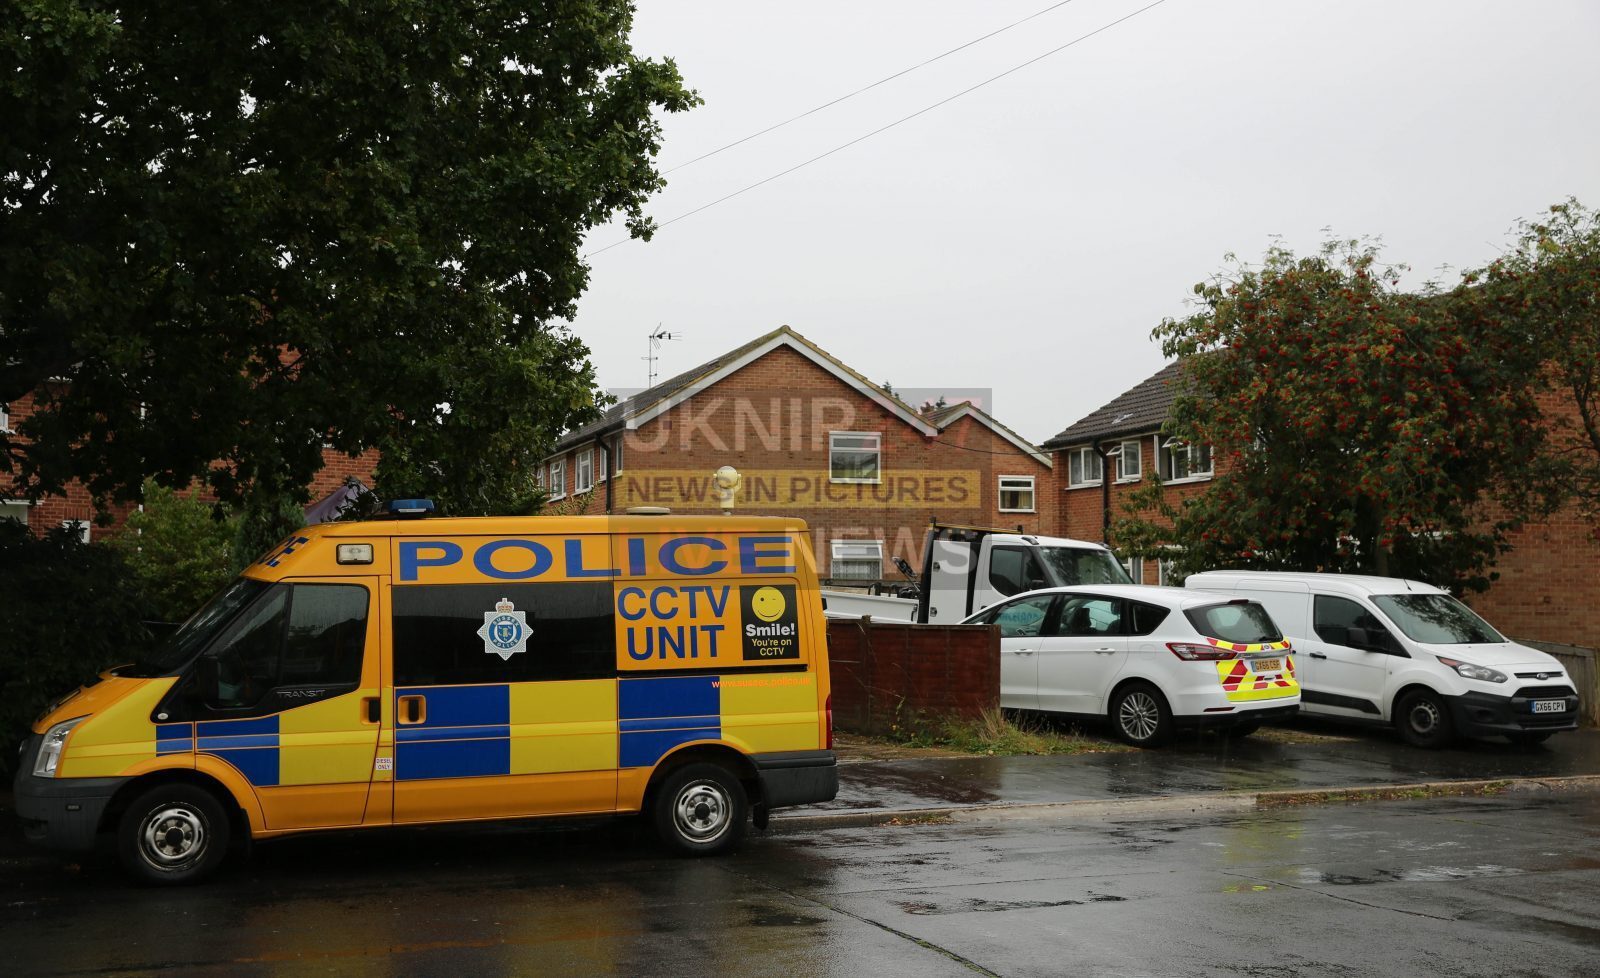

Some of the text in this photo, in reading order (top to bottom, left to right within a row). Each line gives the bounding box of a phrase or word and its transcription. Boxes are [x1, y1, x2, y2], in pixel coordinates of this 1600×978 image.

[399, 536, 797, 581] POLICE
[618, 585, 731, 621] CCTV
[745, 622, 795, 637] Smile!
[627, 625, 725, 660] UNIT
[752, 638, 792, 647] You're on
[759, 647, 784, 656] CCTV
[276, 690, 326, 698] TRANSIT
[1535, 701, 1565, 711] GX66 CPV
